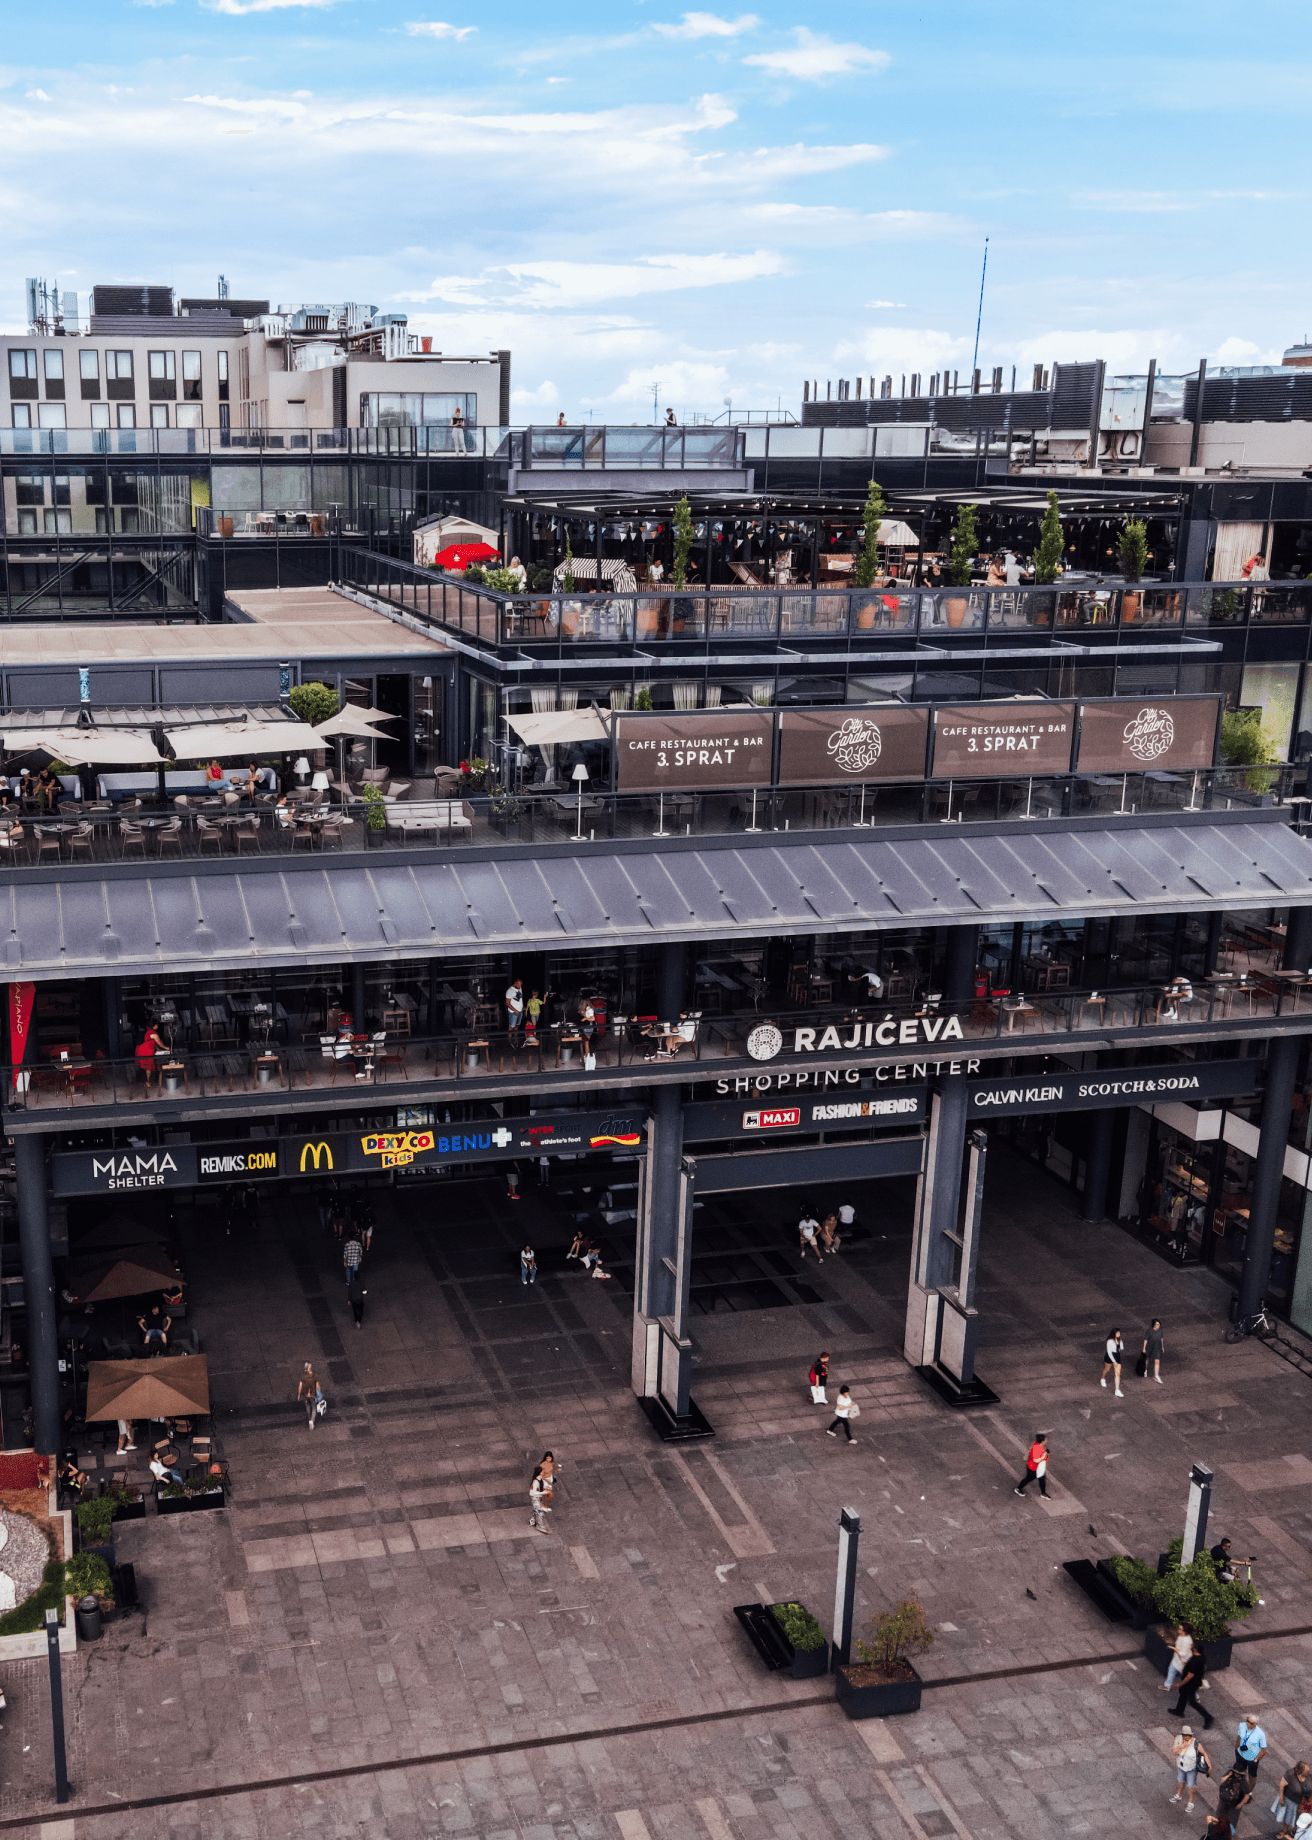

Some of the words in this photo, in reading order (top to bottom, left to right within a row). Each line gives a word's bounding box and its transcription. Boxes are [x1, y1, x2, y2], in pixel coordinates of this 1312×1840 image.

[841, 718, 863, 734] City
[1137, 708, 1158, 725] City
[942, 727, 967, 736] CAFE
[971, 725, 1035, 735] RESTAURANT
[1038, 725, 1044, 733] &
[1047, 724, 1067, 733] BAR
[1122, 718, 1165, 744] Garden
[629, 741, 656, 750] CAFE
[660, 739, 730, 749] RESTAURANT
[733, 739, 739, 747] &
[743, 737, 764, 746] BAR
[827, 728, 873, 756] Garden
[967, 738, 979, 752] 3.
[983, 736, 1041, 752] SPRAT
[657, 752, 670, 767] 3.
[674, 749, 736, 766] SPRAT
[794, 1013, 964, 1052] RAJIĆEVA
[716, 1068, 860, 1094] SHOPPING
[875, 1058, 981, 1081] CENTER
[974, 1089, 1023, 1106] CALVIN
[1025, 1086, 1063, 1102] KLEIN
[1078, 1076, 1200, 1097] SCOTCH&SODA
[763, 1111, 796, 1125] MAXI
[812, 1098, 918, 1121] FASHION&FRIENDS
[597, 1114, 635, 1136] dm
[366, 1135, 405, 1152] DEXY
[409, 1134, 431, 1149] CO
[438, 1133, 492, 1153] BENU
[520, 1140, 532, 1148] the
[568, 1136, 582, 1144] foot
[92, 1152, 178, 1178] MAMA
[201, 1152, 277, 1175] REMIKS.COM
[384, 1152, 413, 1167] kids
[108, 1175, 165, 1190] SHELTER
